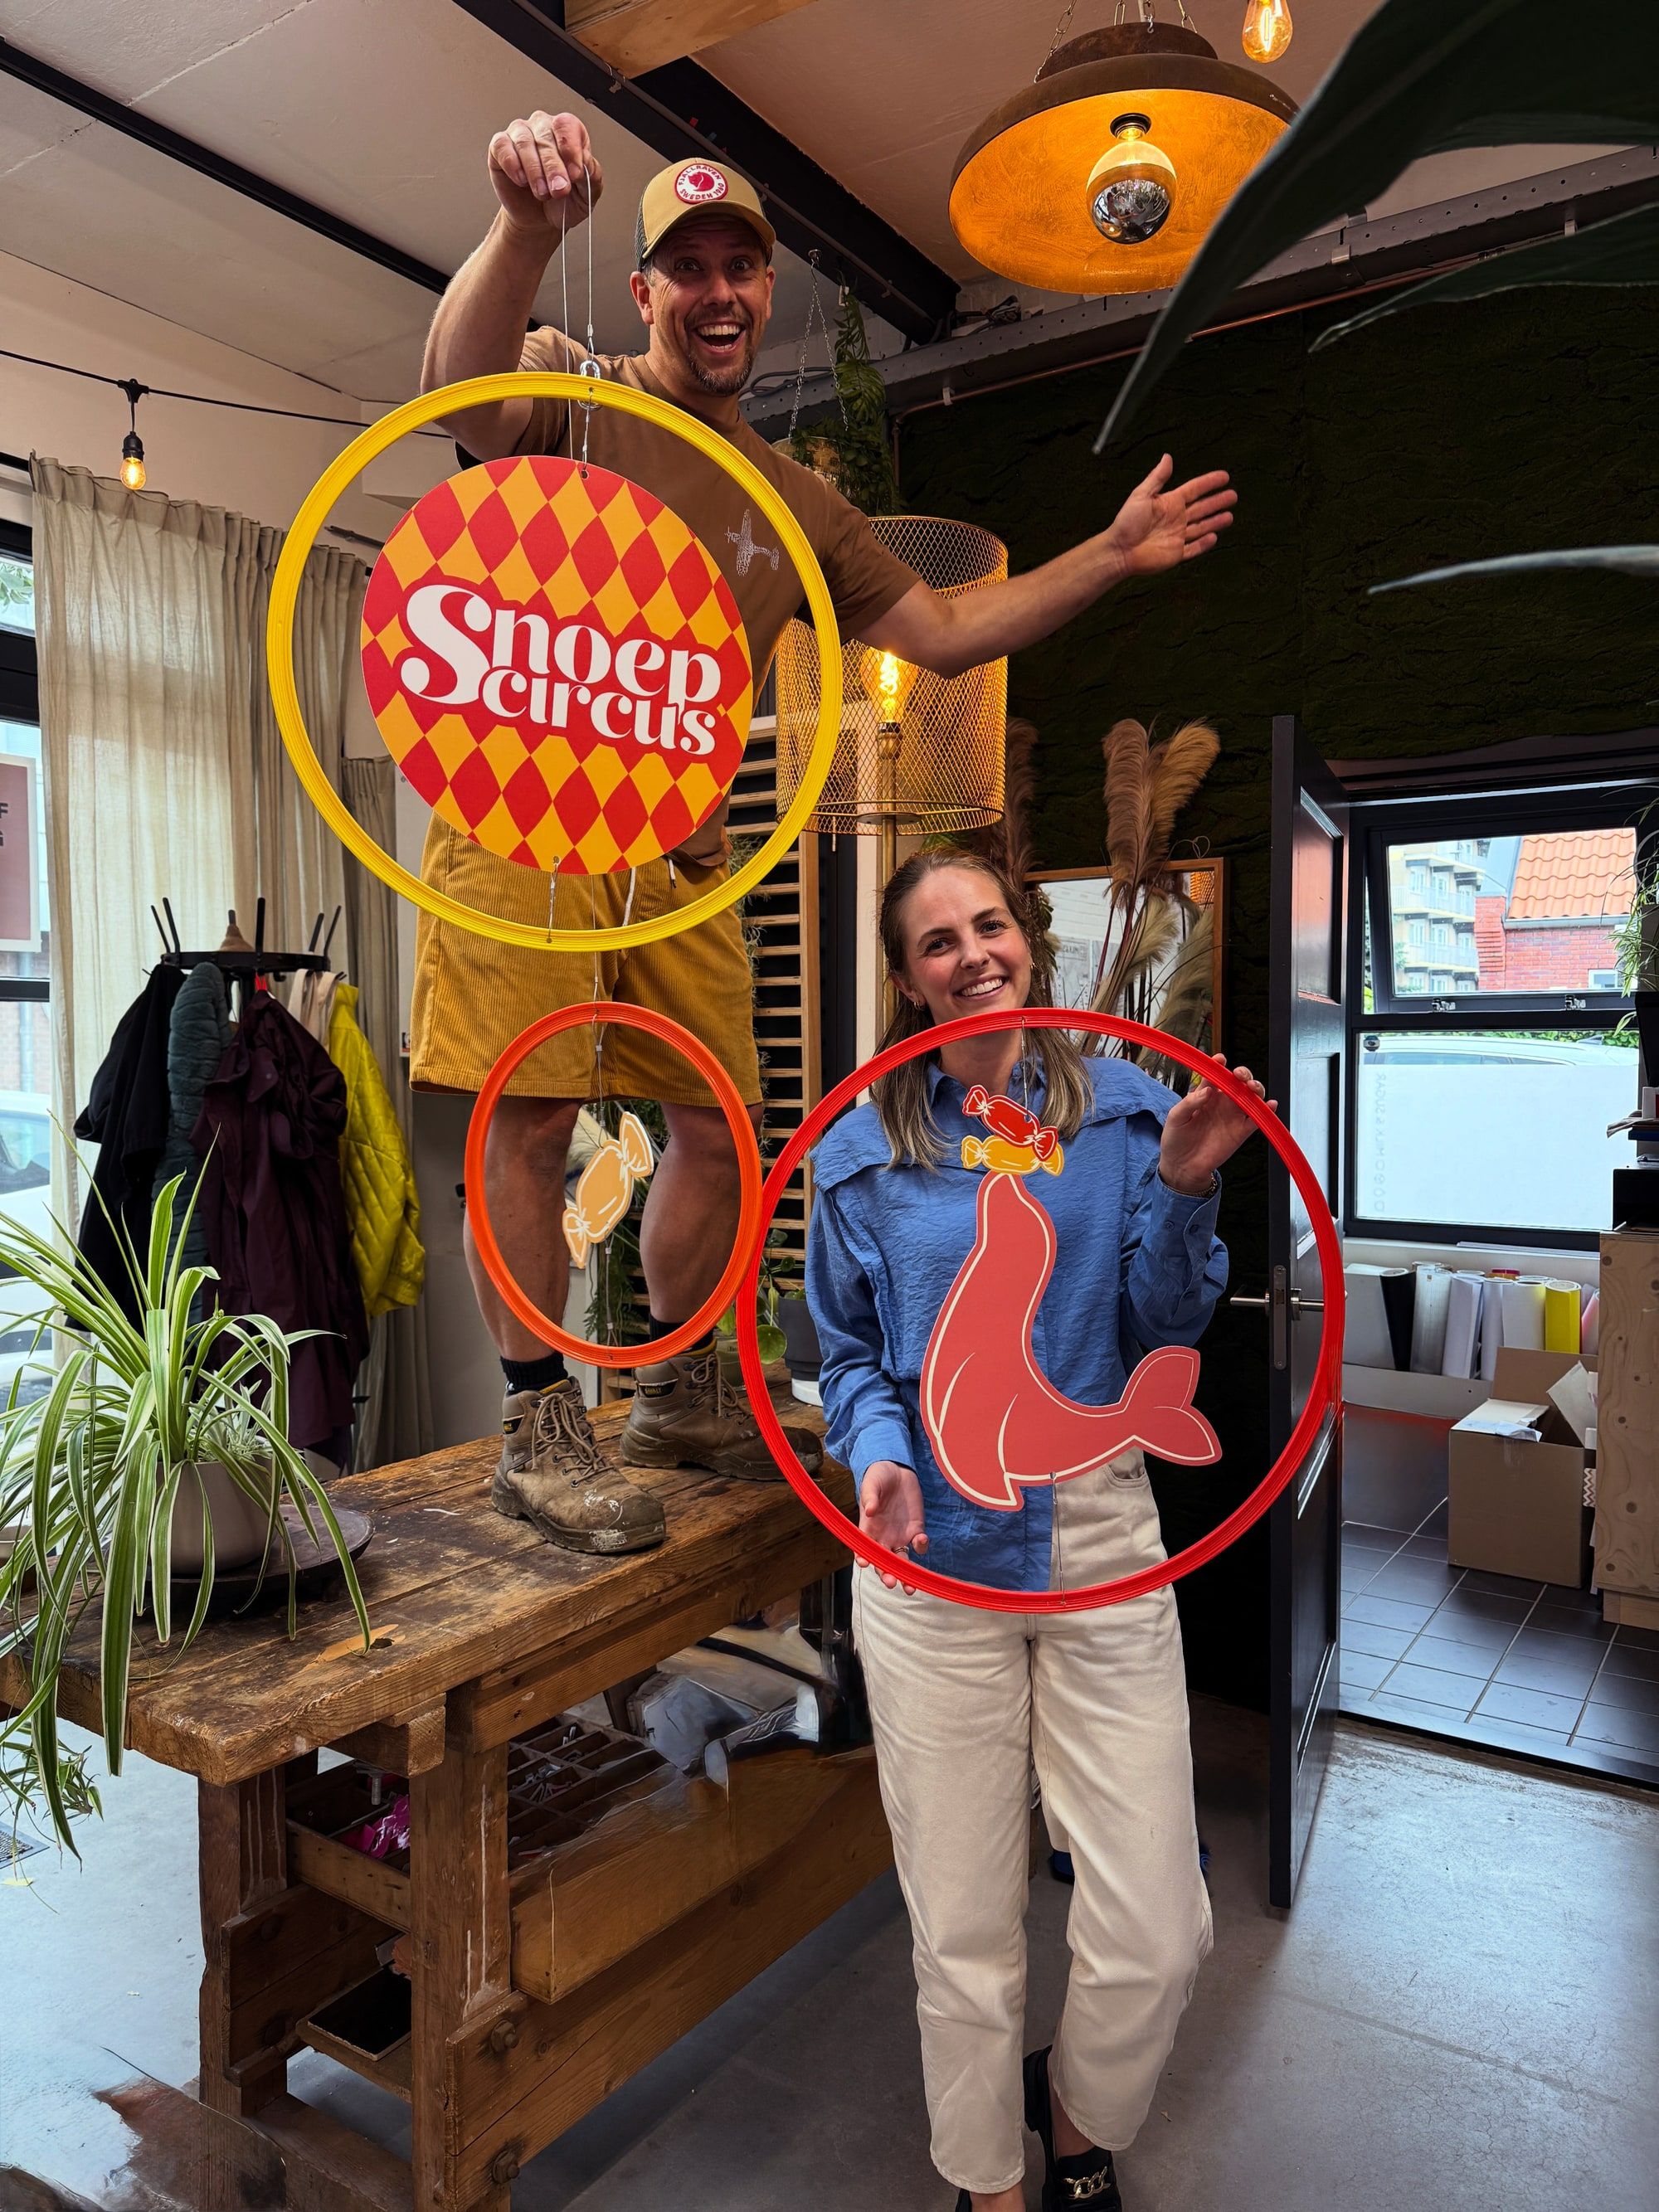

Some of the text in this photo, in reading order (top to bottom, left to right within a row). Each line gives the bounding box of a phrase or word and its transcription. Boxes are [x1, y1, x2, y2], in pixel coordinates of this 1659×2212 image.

[680, 182, 724, 200] SWEDEN 1960
[401, 584, 722, 725] Snoep
[482, 669, 716, 755] circus
